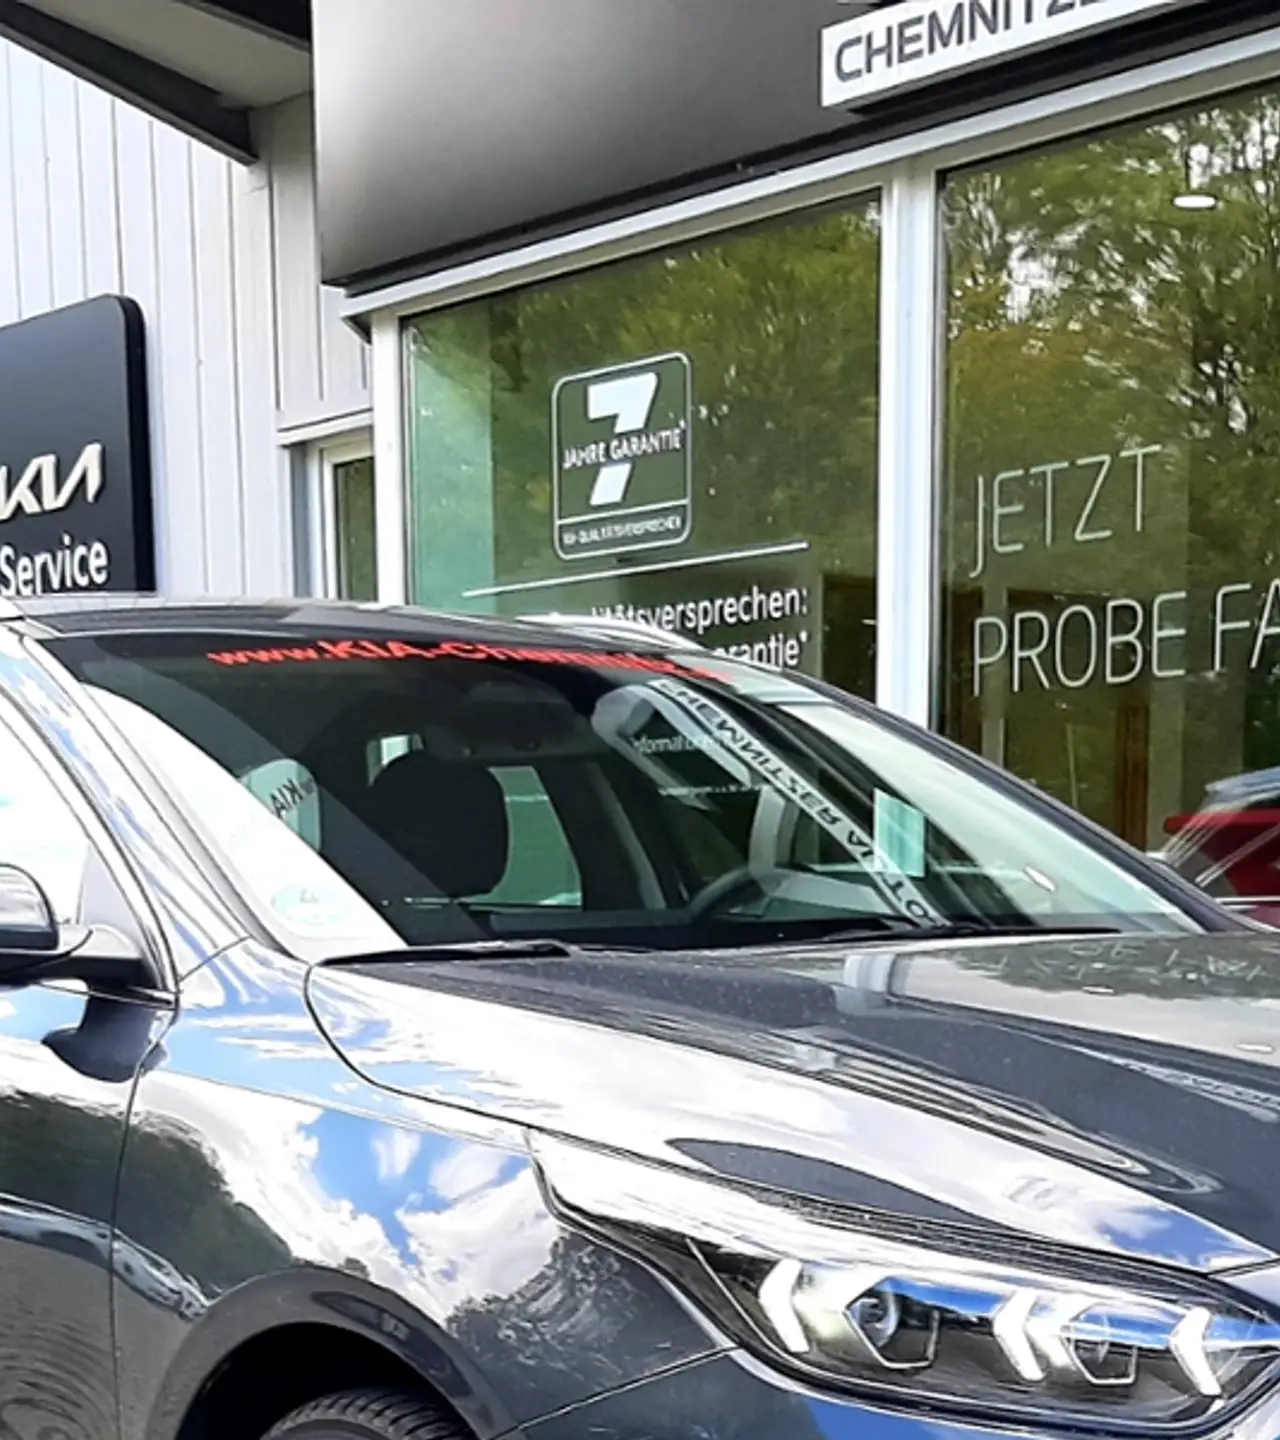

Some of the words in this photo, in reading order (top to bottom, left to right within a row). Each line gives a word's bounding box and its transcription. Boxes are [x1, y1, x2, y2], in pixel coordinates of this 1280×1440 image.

[835, 0, 1112, 82] CHEMNIT
[563, 441, 608, 470] JAHRE
[588, 372, 658, 506] 7
[970, 444, 1163, 578] JETZT
[972, 591, 1188, 697] PROBE
